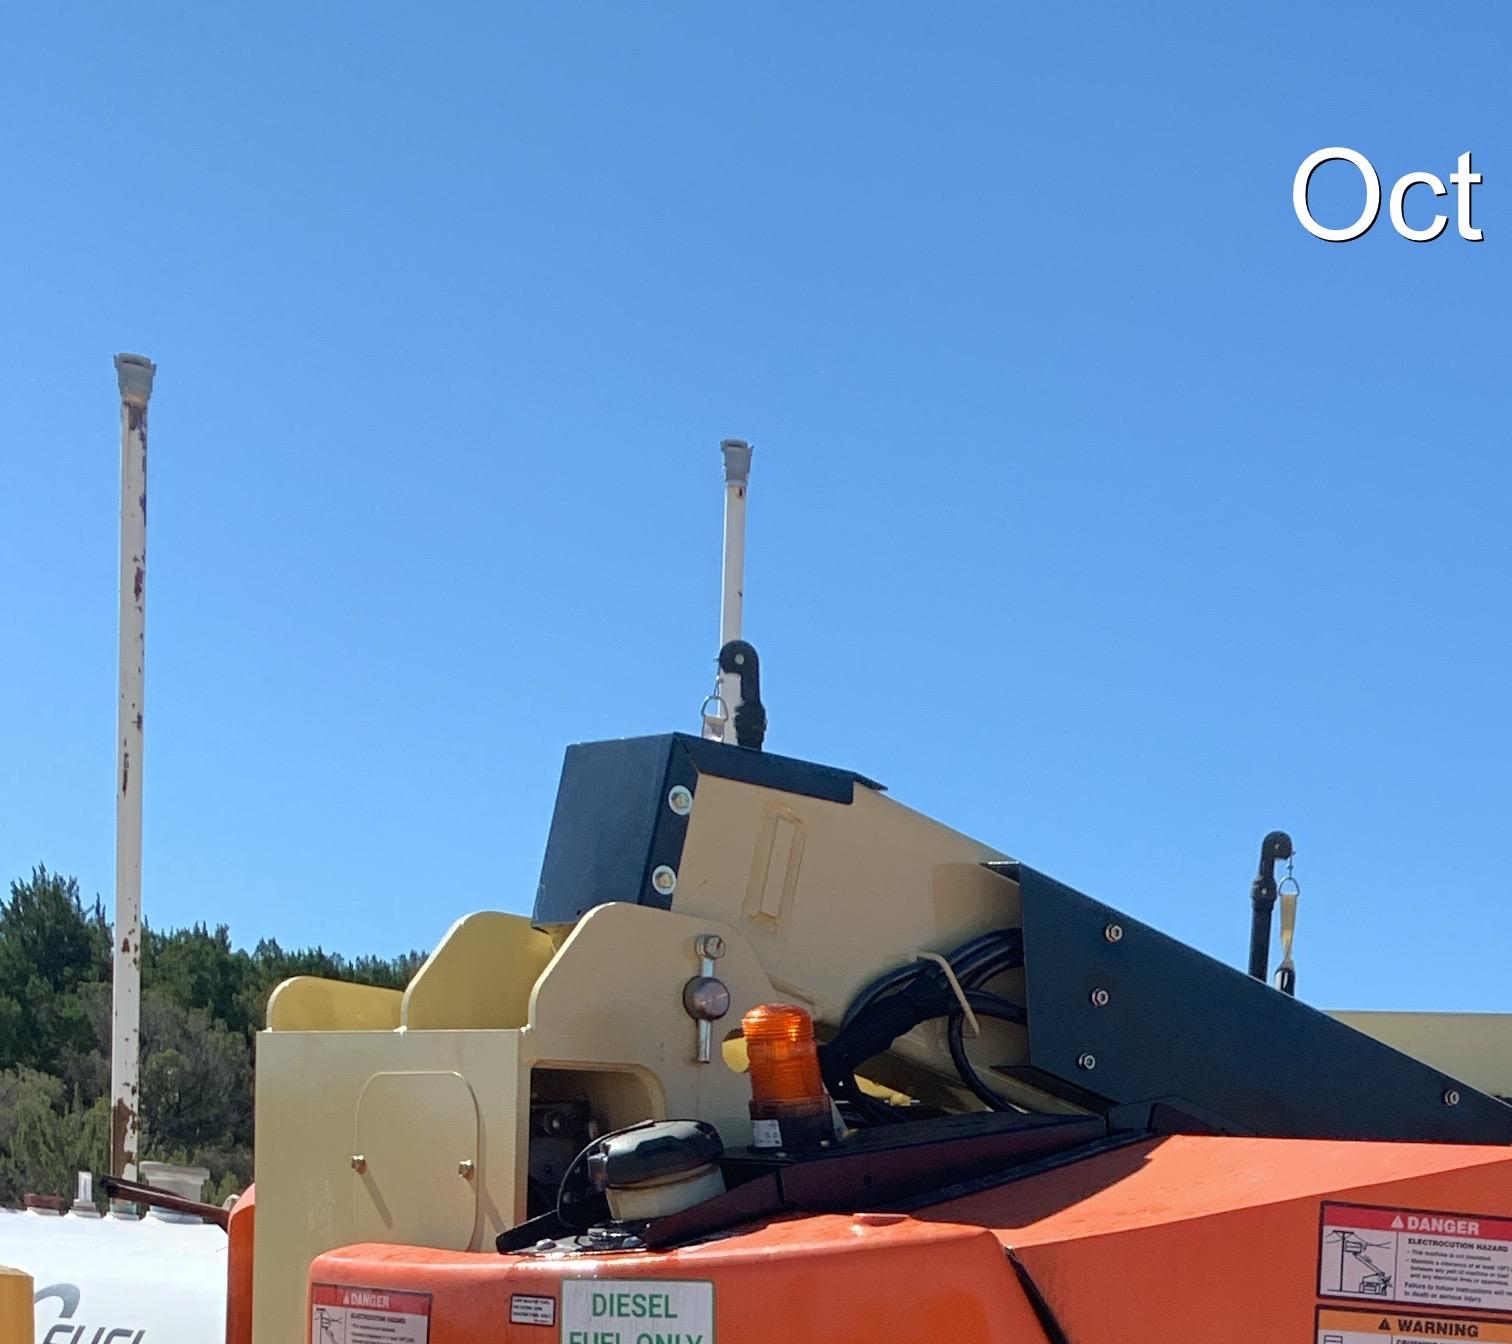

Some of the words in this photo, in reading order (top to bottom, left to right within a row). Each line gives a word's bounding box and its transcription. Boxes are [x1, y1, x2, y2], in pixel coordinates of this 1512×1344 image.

[1407, 1216, 1480, 1235] DANGER
[1408, 1238, 1474, 1250] ELECTROCUTION
[1477, 1243, 1508, 1252] HAZARD
[350, 1292, 390, 1309] DANGER
[591, 1292, 678, 1319] DIESEL
[1397, 1318, 1479, 1338] WARNING
